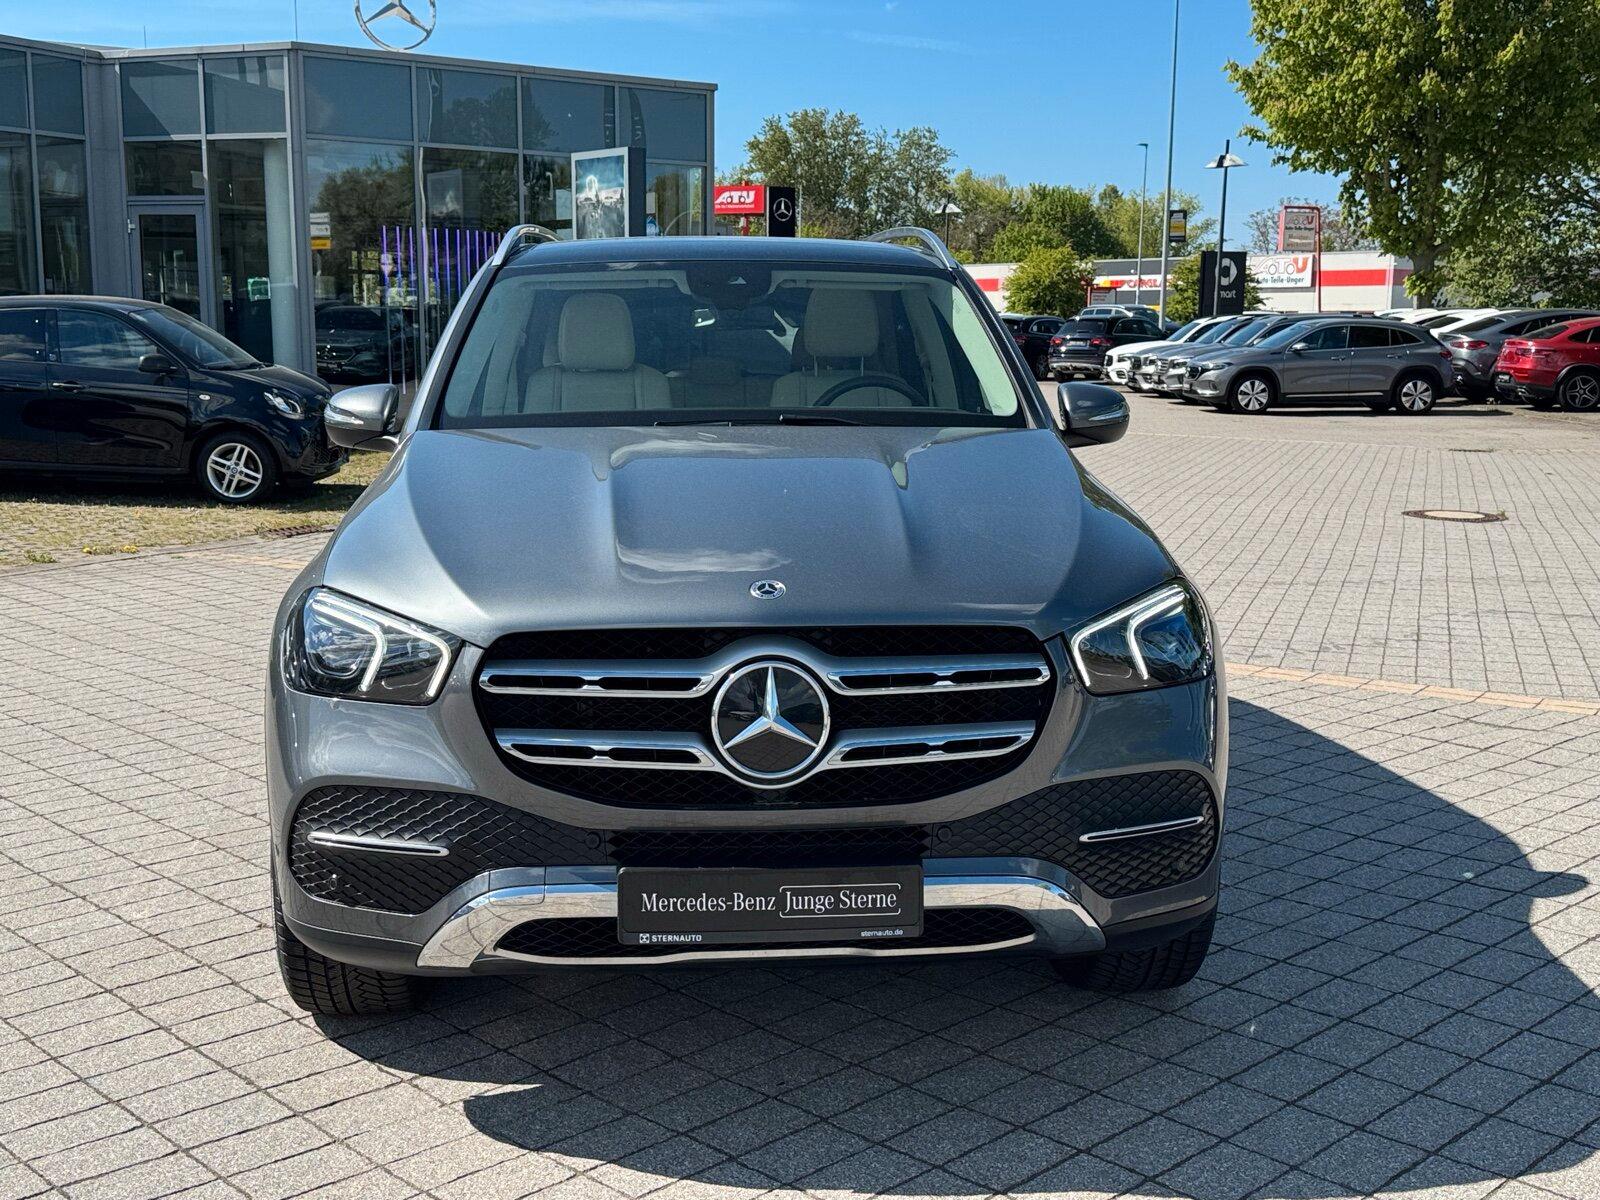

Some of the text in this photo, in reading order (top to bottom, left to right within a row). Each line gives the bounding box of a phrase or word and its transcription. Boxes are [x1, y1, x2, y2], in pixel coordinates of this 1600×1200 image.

[1218, 290, 1236, 298] mart
[640, 889, 897, 913] Mercedes-Benz Junge Sterne
[860, 928, 904, 937] sternauto.de
[651, 934, 702, 942] STERNAUTO
